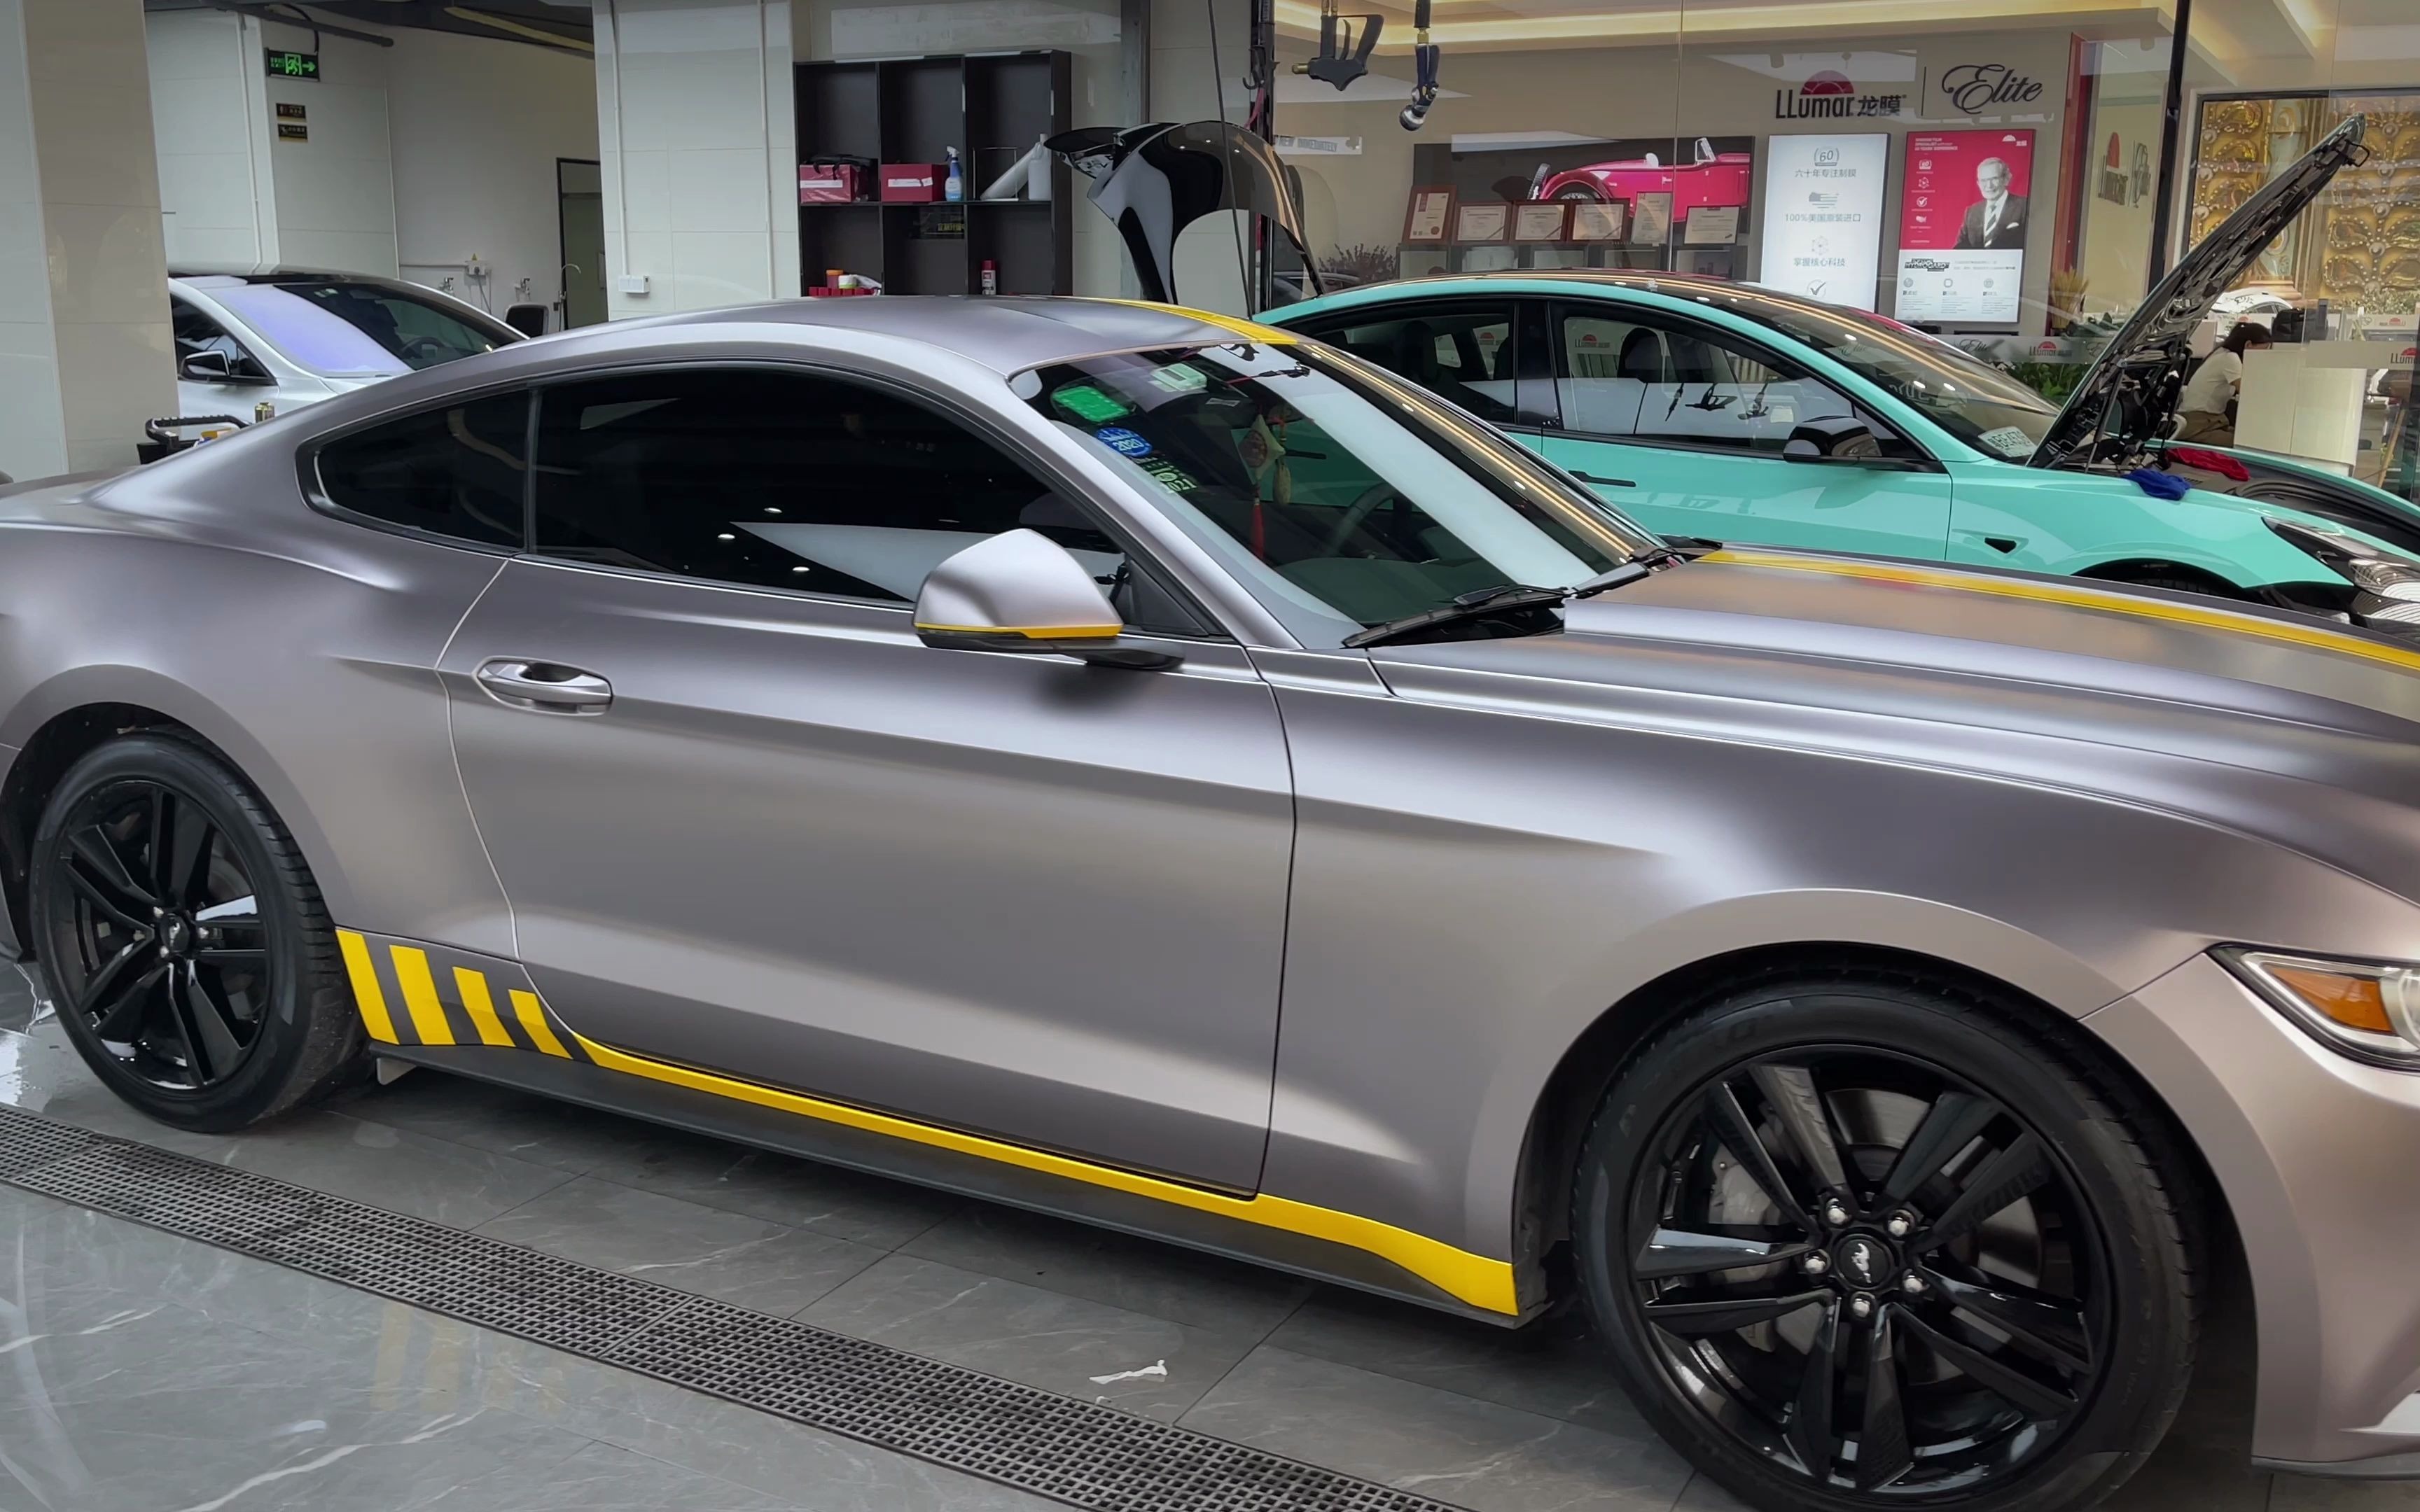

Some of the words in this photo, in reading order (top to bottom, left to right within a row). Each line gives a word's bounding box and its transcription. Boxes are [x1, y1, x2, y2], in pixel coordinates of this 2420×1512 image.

[1941, 64, 2043, 114] Elite
[1776, 89, 1854, 119] LLumar
[1858, 96, 1901, 117] 龙膜
[1819, 150, 1834, 162] 60
[1113, 438, 1144, 451] 2020
